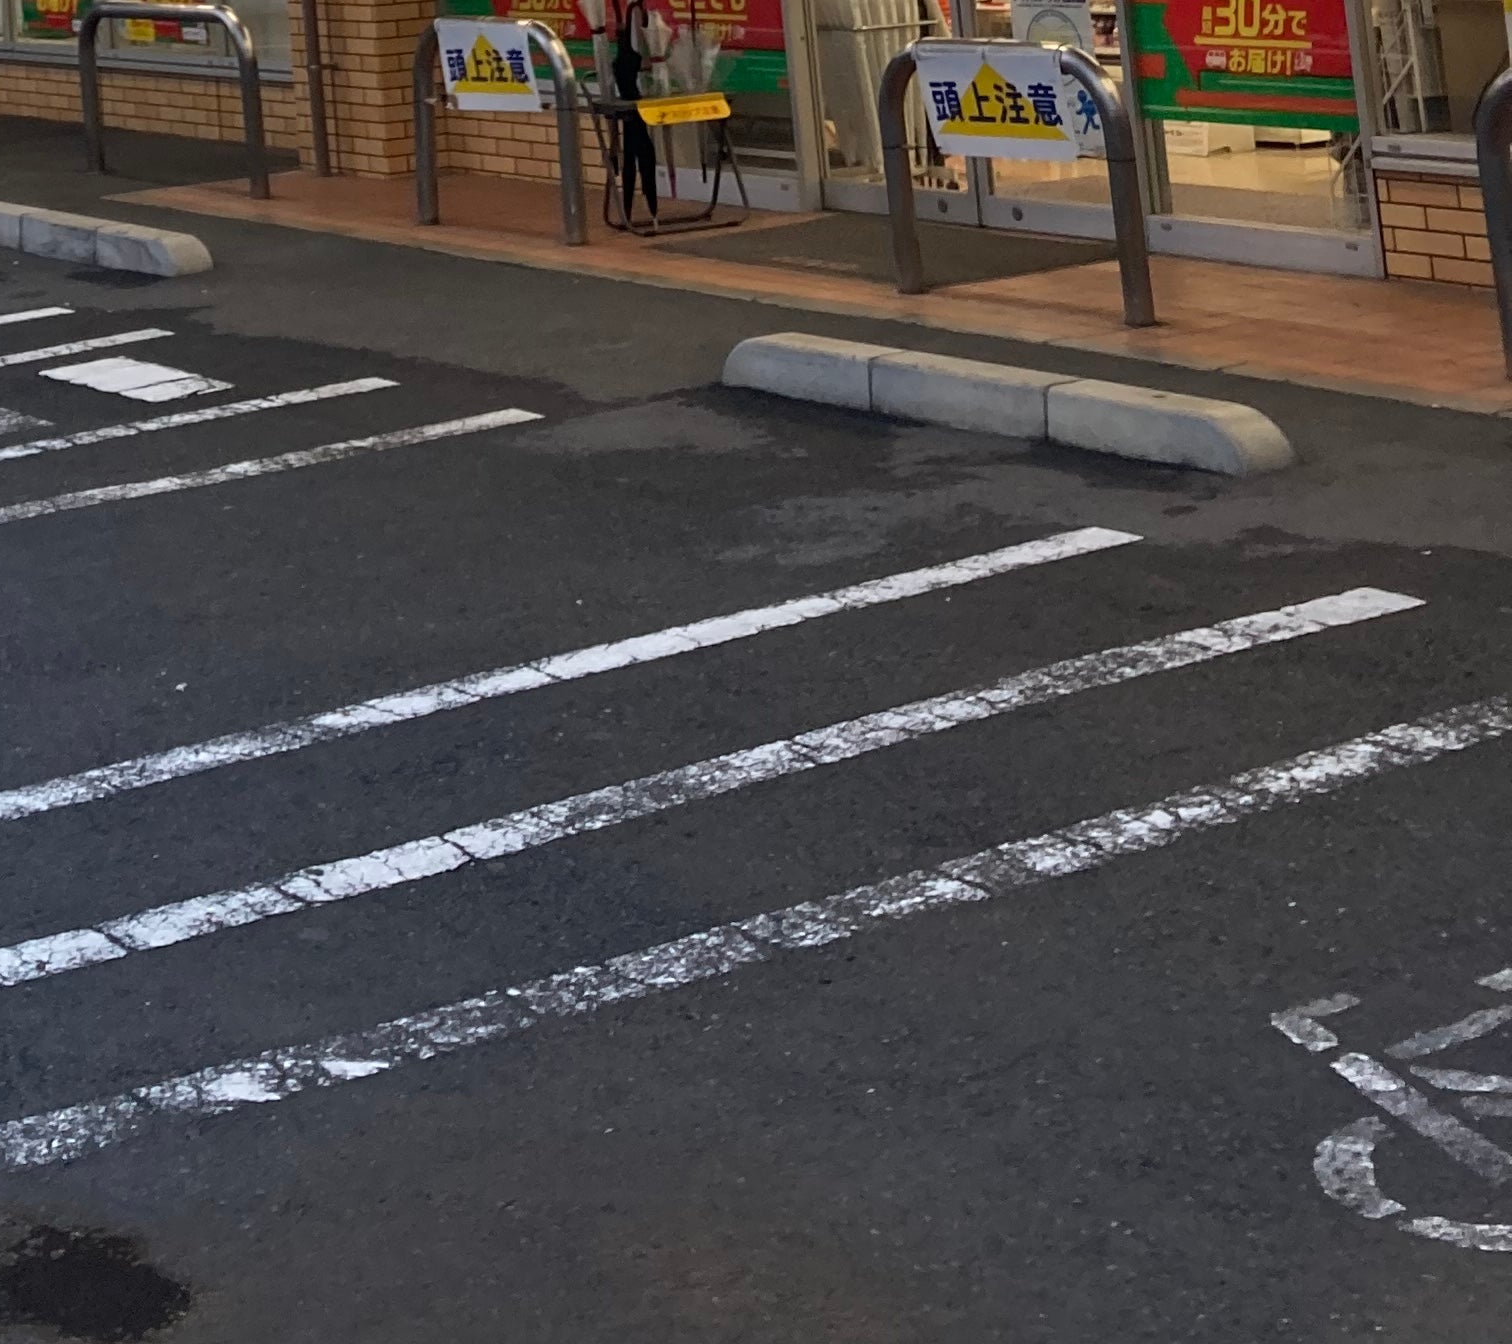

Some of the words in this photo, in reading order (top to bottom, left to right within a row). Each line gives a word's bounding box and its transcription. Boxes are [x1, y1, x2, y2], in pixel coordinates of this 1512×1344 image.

[445, 48, 530, 84] 頭上注意
[1228, 49, 1292, 76] お届け!
[929, 81, 1064, 127] 頭上注意
